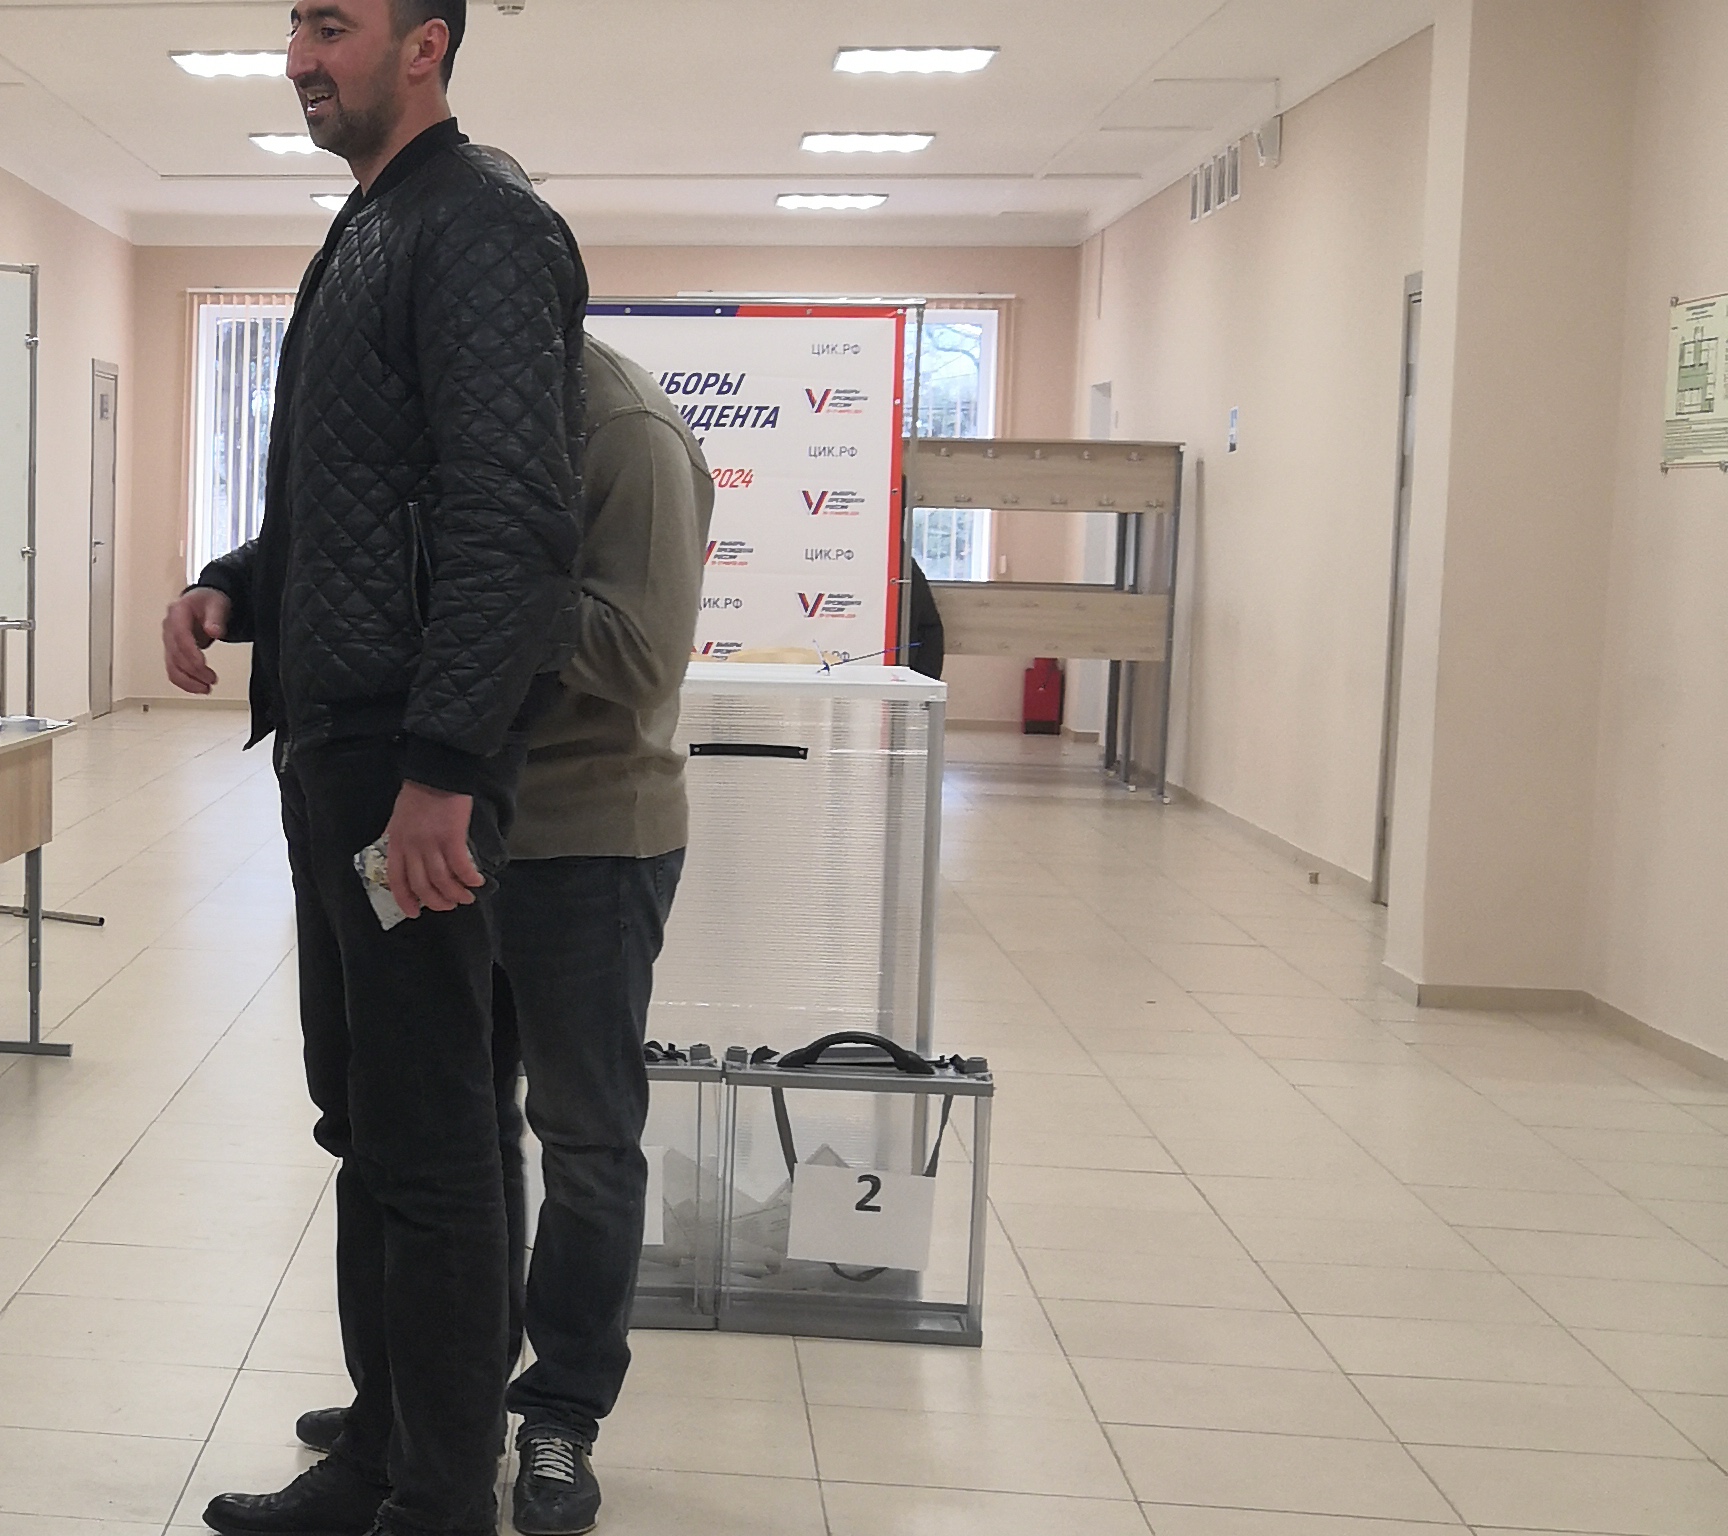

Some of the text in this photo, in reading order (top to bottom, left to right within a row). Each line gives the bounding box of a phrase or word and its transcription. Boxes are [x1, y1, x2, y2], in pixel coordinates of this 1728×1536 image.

[811, 343, 861, 356] ЦИК.РФ
[808, 445, 858, 458] ЦИК.РФ
[710, 468, 754, 488] 2024
[804, 548, 854, 561] ЦИК.РФ
[854, 1173, 882, 1213] 2
